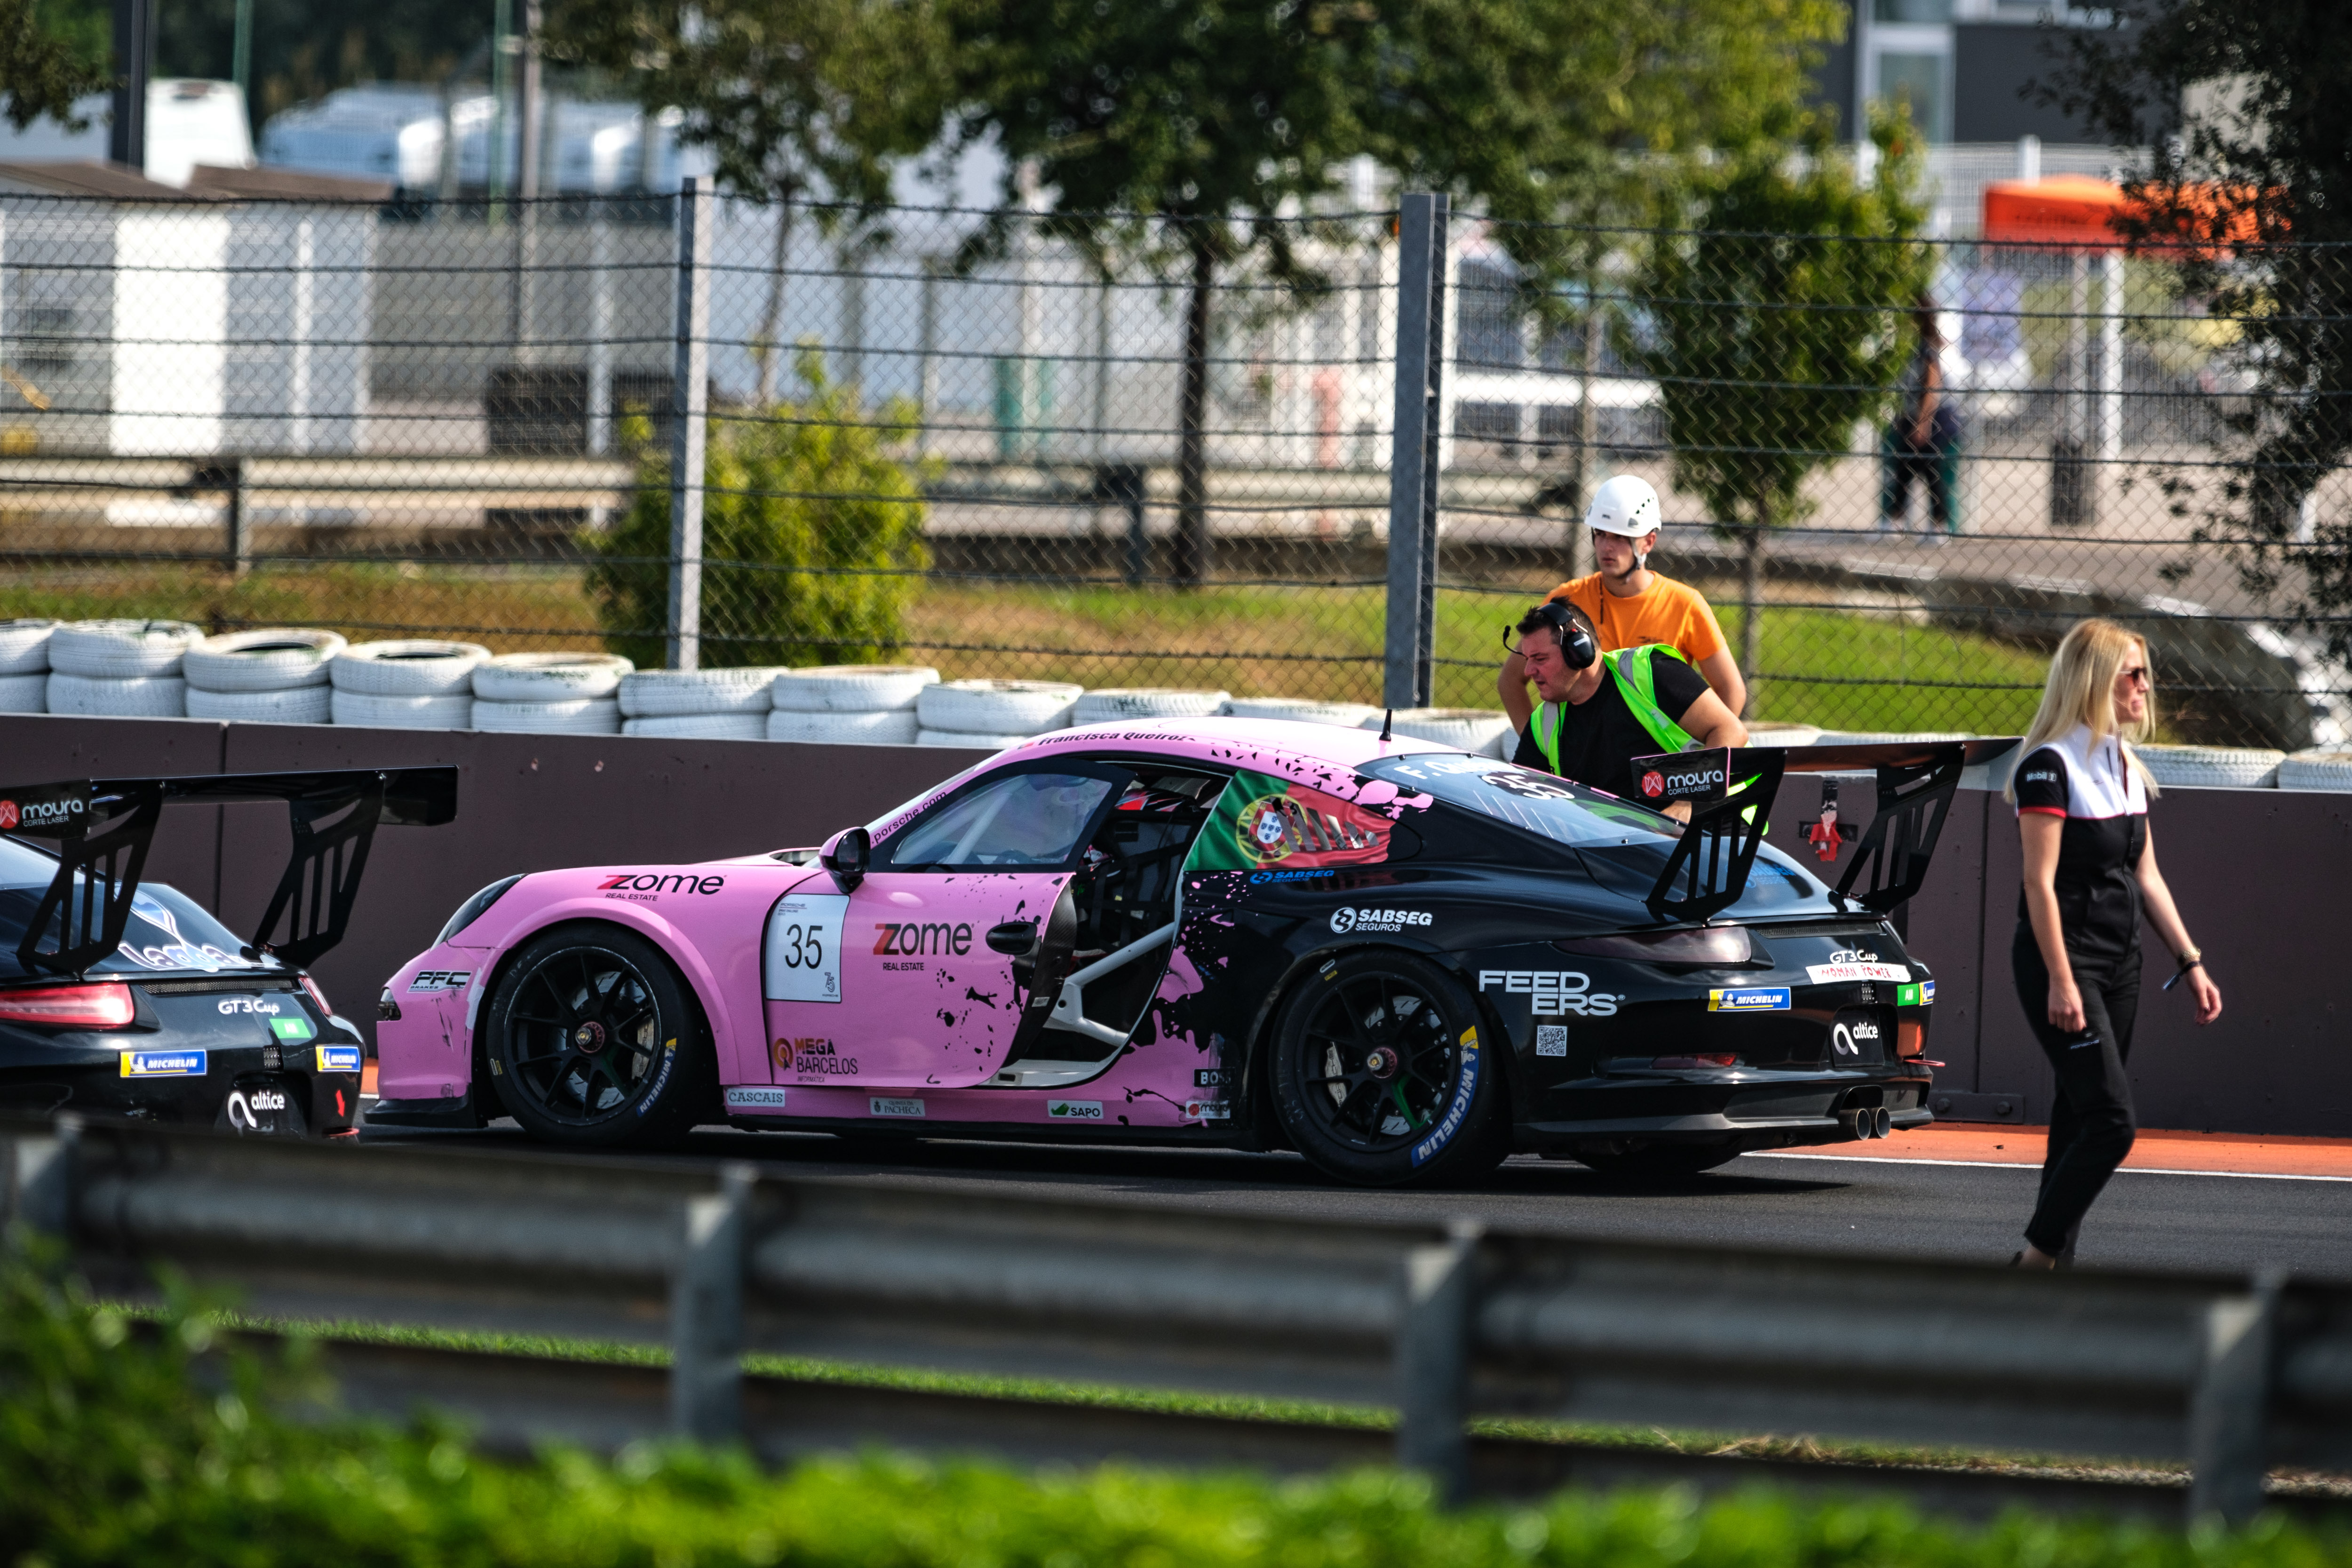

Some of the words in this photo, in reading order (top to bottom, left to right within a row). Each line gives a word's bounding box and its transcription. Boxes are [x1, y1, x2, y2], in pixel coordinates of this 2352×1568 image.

[1038, 733, 1120, 745] Francisca
[1667, 771, 1724, 788] moura
[2027, 772, 2047, 781] Mobil
[22, 800, 83, 819] moura
[24, 818, 46, 827] CORTE
[597, 875, 724, 895] zome
[1358, 909, 1432, 925] SABSEG
[1355, 923, 1401, 932] SEGUROS
[785, 924, 823, 969] 35
[873, 923, 972, 955] zome
[413, 971, 471, 986] PFC
[1860, 965, 1891, 978] POWER
[1479, 971, 1589, 993] FEED
[1532, 993, 1617, 1016] ERS
[1736, 995, 1782, 1004] MICHELIN
[1853, 1022, 1878, 1039] altice
[795, 1038, 835, 1055] MEGA
[147, 1059, 197, 1068] MICHELIN
[331, 1055, 356, 1064] MICHELIN
[796, 1057, 858, 1075] BARCELOS
[640, 1060, 671, 1113] MICHELIN
[251, 1091, 284, 1110] altice
[729, 1092, 783, 1103] CASCAIS
[884, 1106, 921, 1114] PACHECA
[1071, 1107, 1100, 1117] SAPO
[1418, 1068, 1474, 1160] MICHELIN
